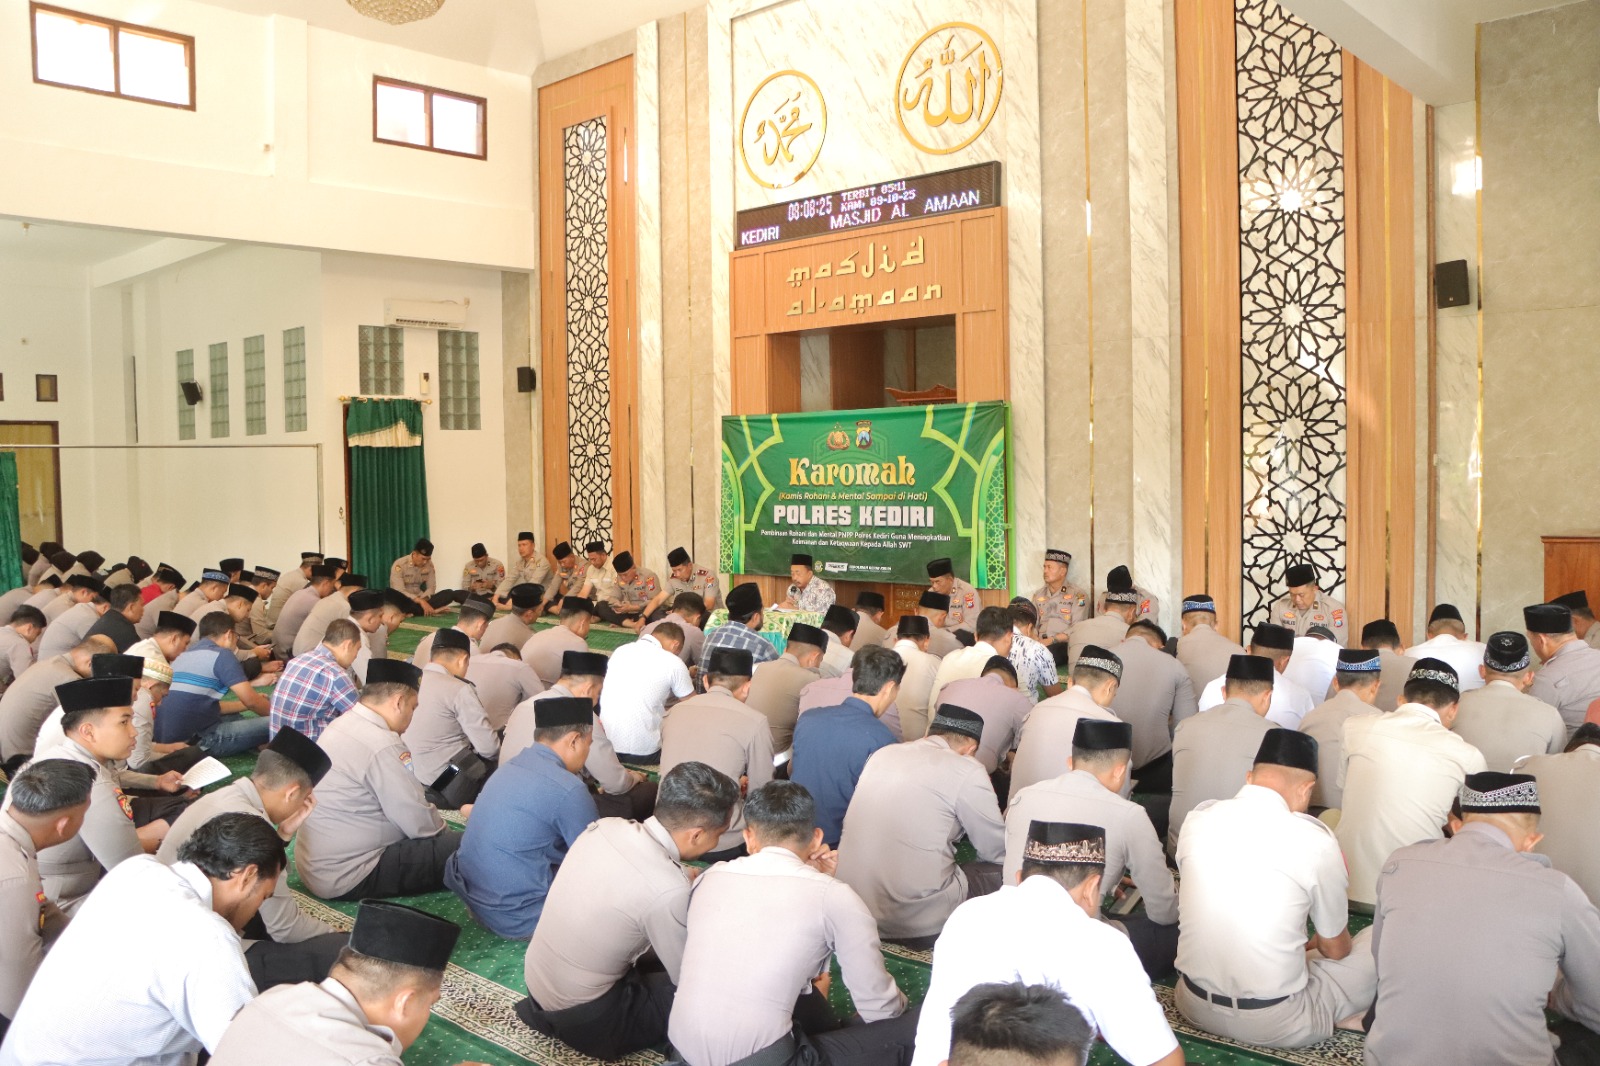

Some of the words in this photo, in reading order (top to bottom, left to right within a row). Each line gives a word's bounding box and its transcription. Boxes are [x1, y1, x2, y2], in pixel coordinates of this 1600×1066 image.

[841, 187, 876, 201] TERBIT
[881, 181, 906, 194] 05:11
[870, 189, 916, 206] 09-10-25
[787, 195, 832, 222] 08:08:25
[830, 207, 881, 229] MASJID
[890, 203, 909, 219] AL
[924, 190, 980, 213] AMAAN
[741, 226, 779, 245] KEDIRI
[786, 235, 925, 287] masjid
[788, 455, 916, 486] Karomah
[778, 491, 803, 502] (Kamis
[804, 492, 830, 500] Rohani
[831, 492, 837, 500] &
[838, 492, 864, 500] Mental
[866, 492, 896, 502] Sampai
[897, 491, 906, 500] di
[907, 492, 928, 502] Hati)
[773, 505, 852, 526] POLRES
[859, 505, 934, 527] KEDIRI
[860, 541, 882, 549] Kepada
[908, 533, 951, 542] Meningkatkan
